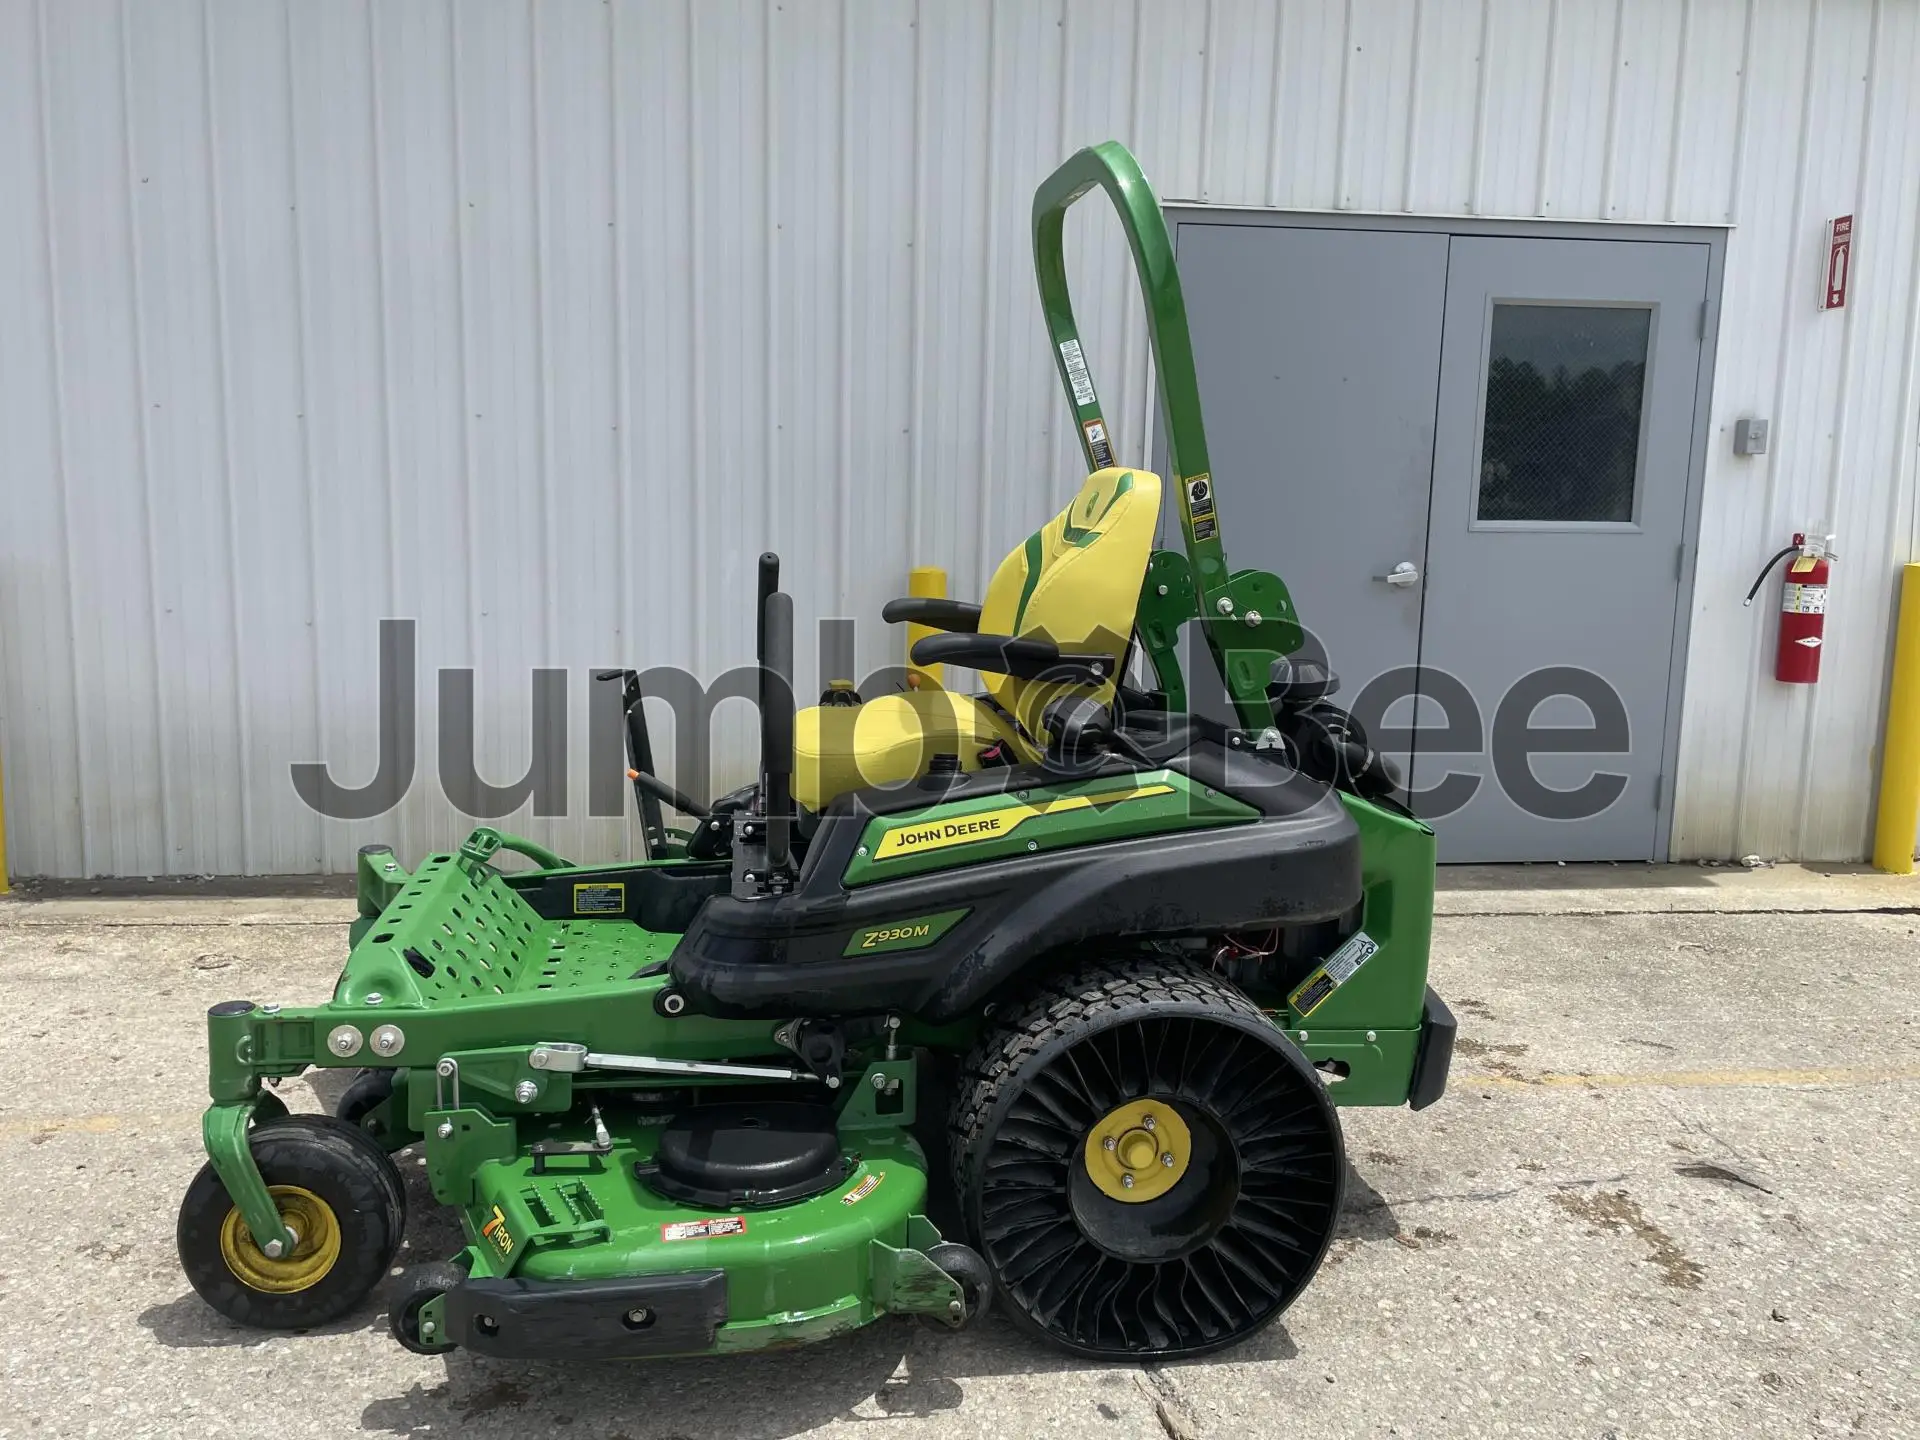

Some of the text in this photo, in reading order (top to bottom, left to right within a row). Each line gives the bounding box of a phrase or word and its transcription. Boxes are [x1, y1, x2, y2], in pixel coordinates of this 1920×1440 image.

[1836, 221, 1850, 233] FIRE
[896, 818, 1001, 847] JOHN DEERE
[862, 924, 930, 948] Z930M
